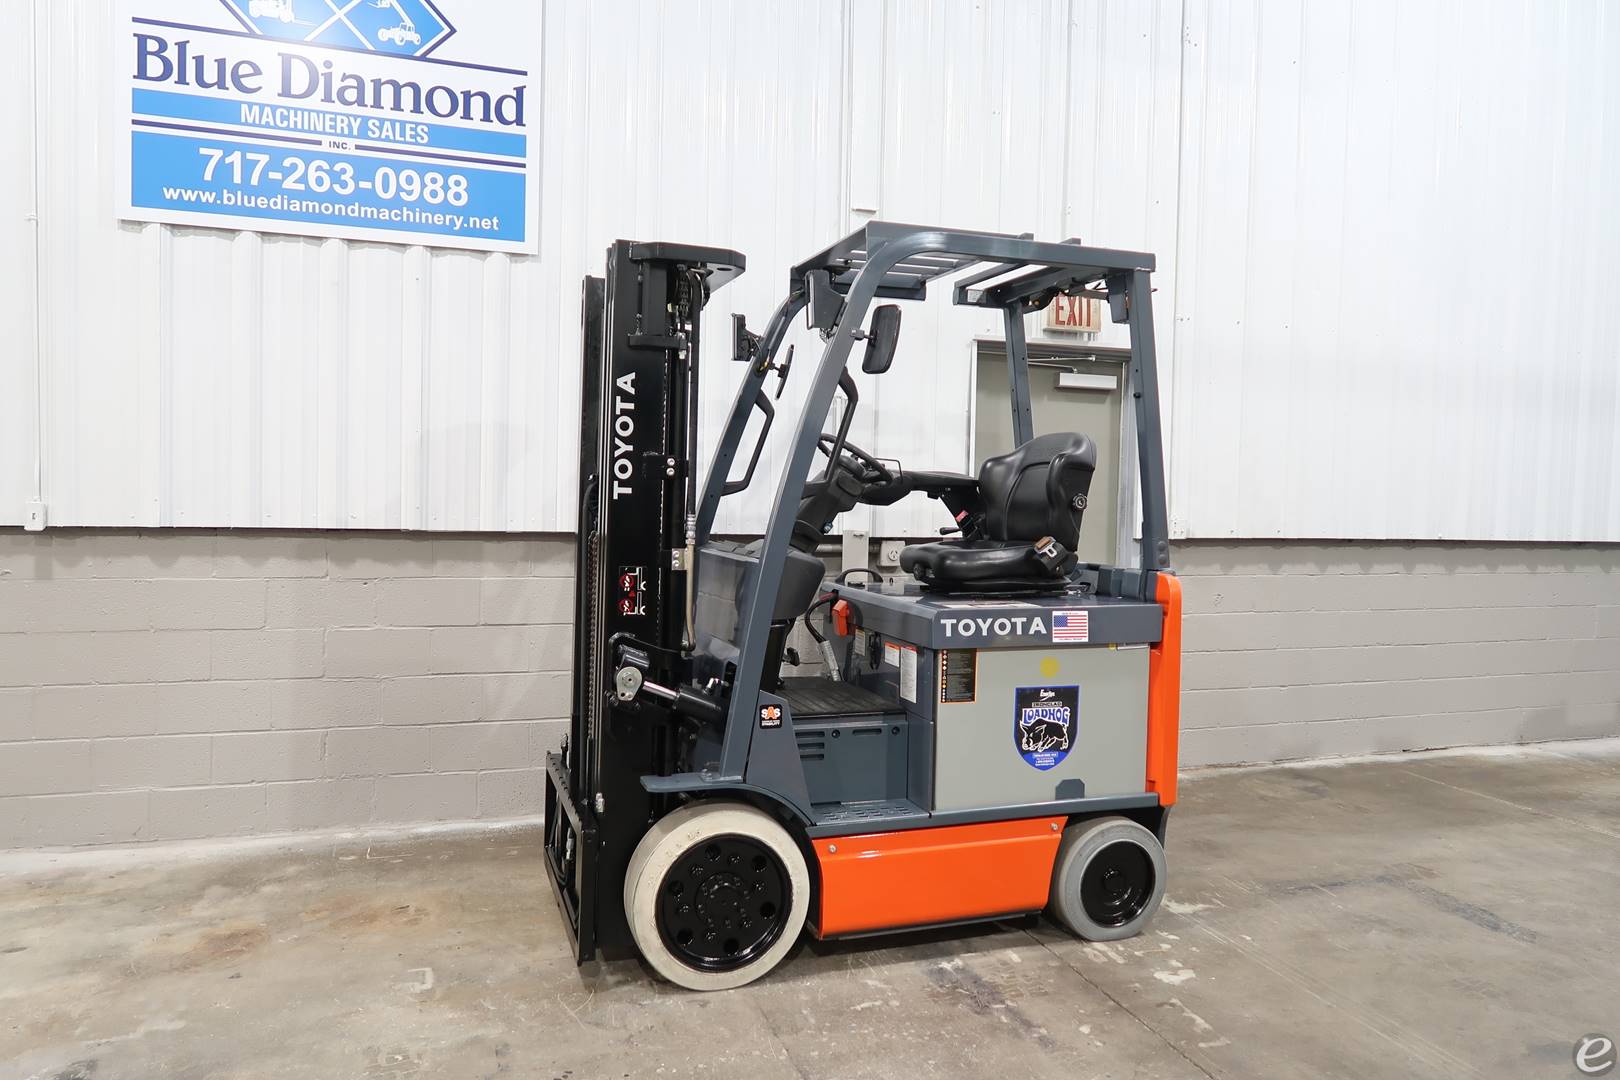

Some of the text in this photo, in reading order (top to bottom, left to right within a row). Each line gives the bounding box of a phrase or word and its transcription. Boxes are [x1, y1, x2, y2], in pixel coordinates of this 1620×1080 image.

[133, 33, 527, 127] Blue Diamond
[240, 103, 429, 143] MACHINERY SALES
[328, 140, 351, 151] INC.
[199, 147, 469, 206] 717-263-0988
[162, 186, 499, 230] www.bluediamondmachinery.net
[613, 372, 636, 500] TOYOTA
[940, 616, 1047, 637] TOYOTA
[761, 706, 781, 719] SAS
[1022, 707, 1070, 726] LOADHOG
